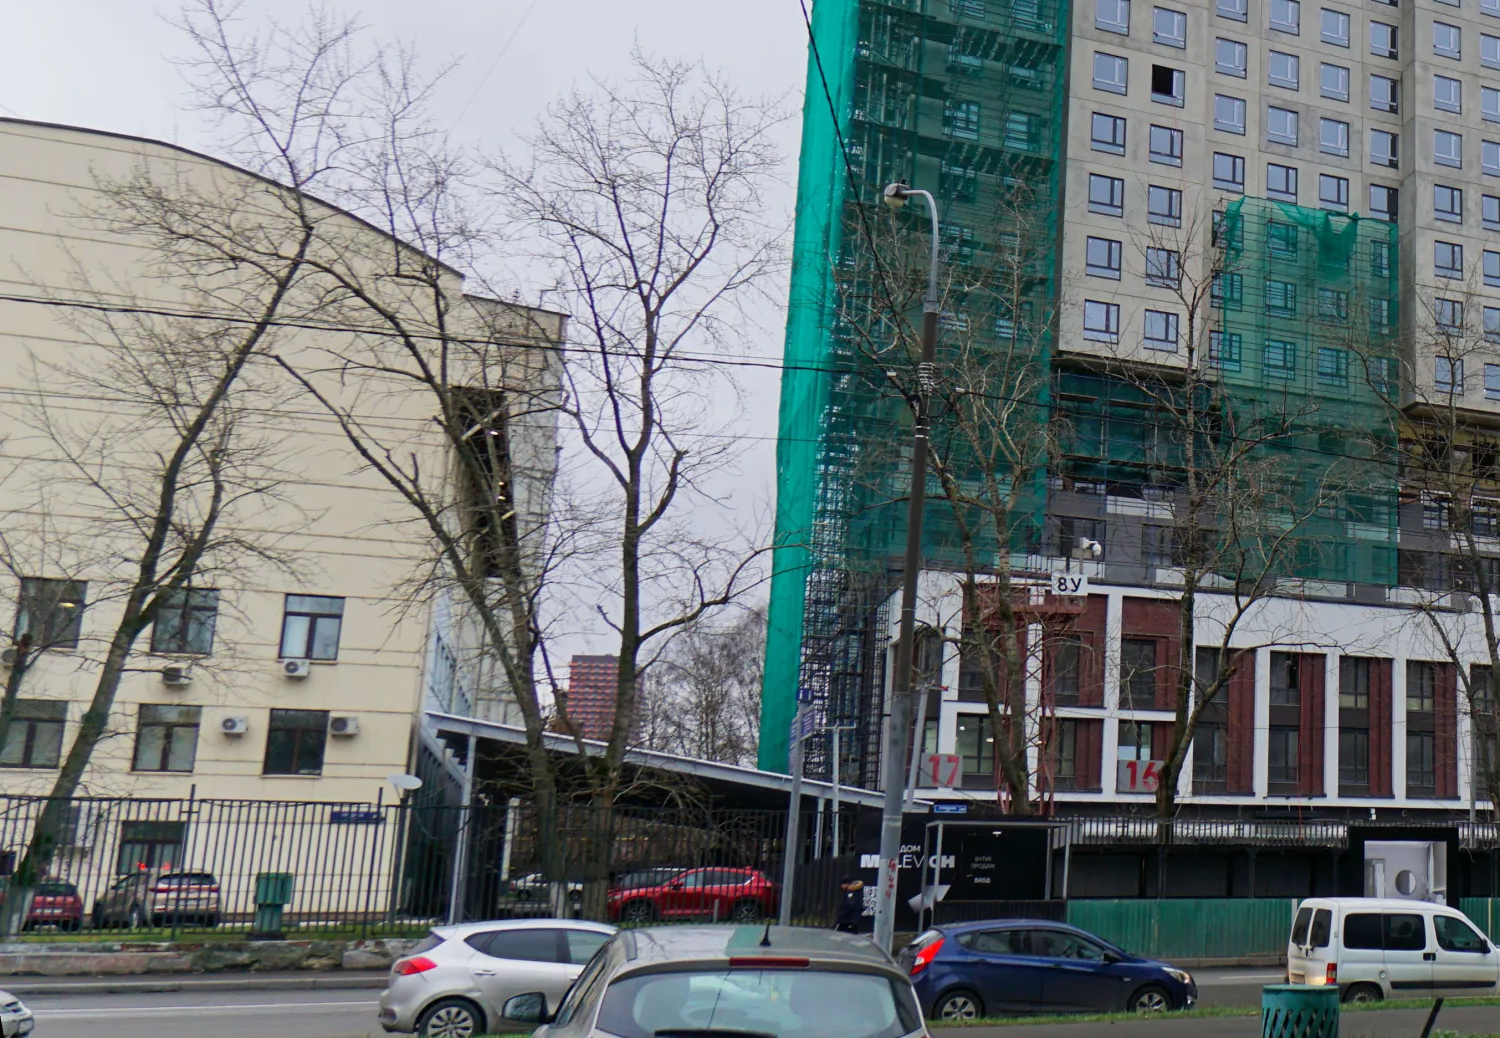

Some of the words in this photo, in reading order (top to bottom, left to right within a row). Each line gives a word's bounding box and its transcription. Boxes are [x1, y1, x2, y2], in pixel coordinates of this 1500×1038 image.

[929, 755, 959, 787] 17
[1126, 761, 1160, 792] 16
[900, 845, 921, 853] ДОМ
